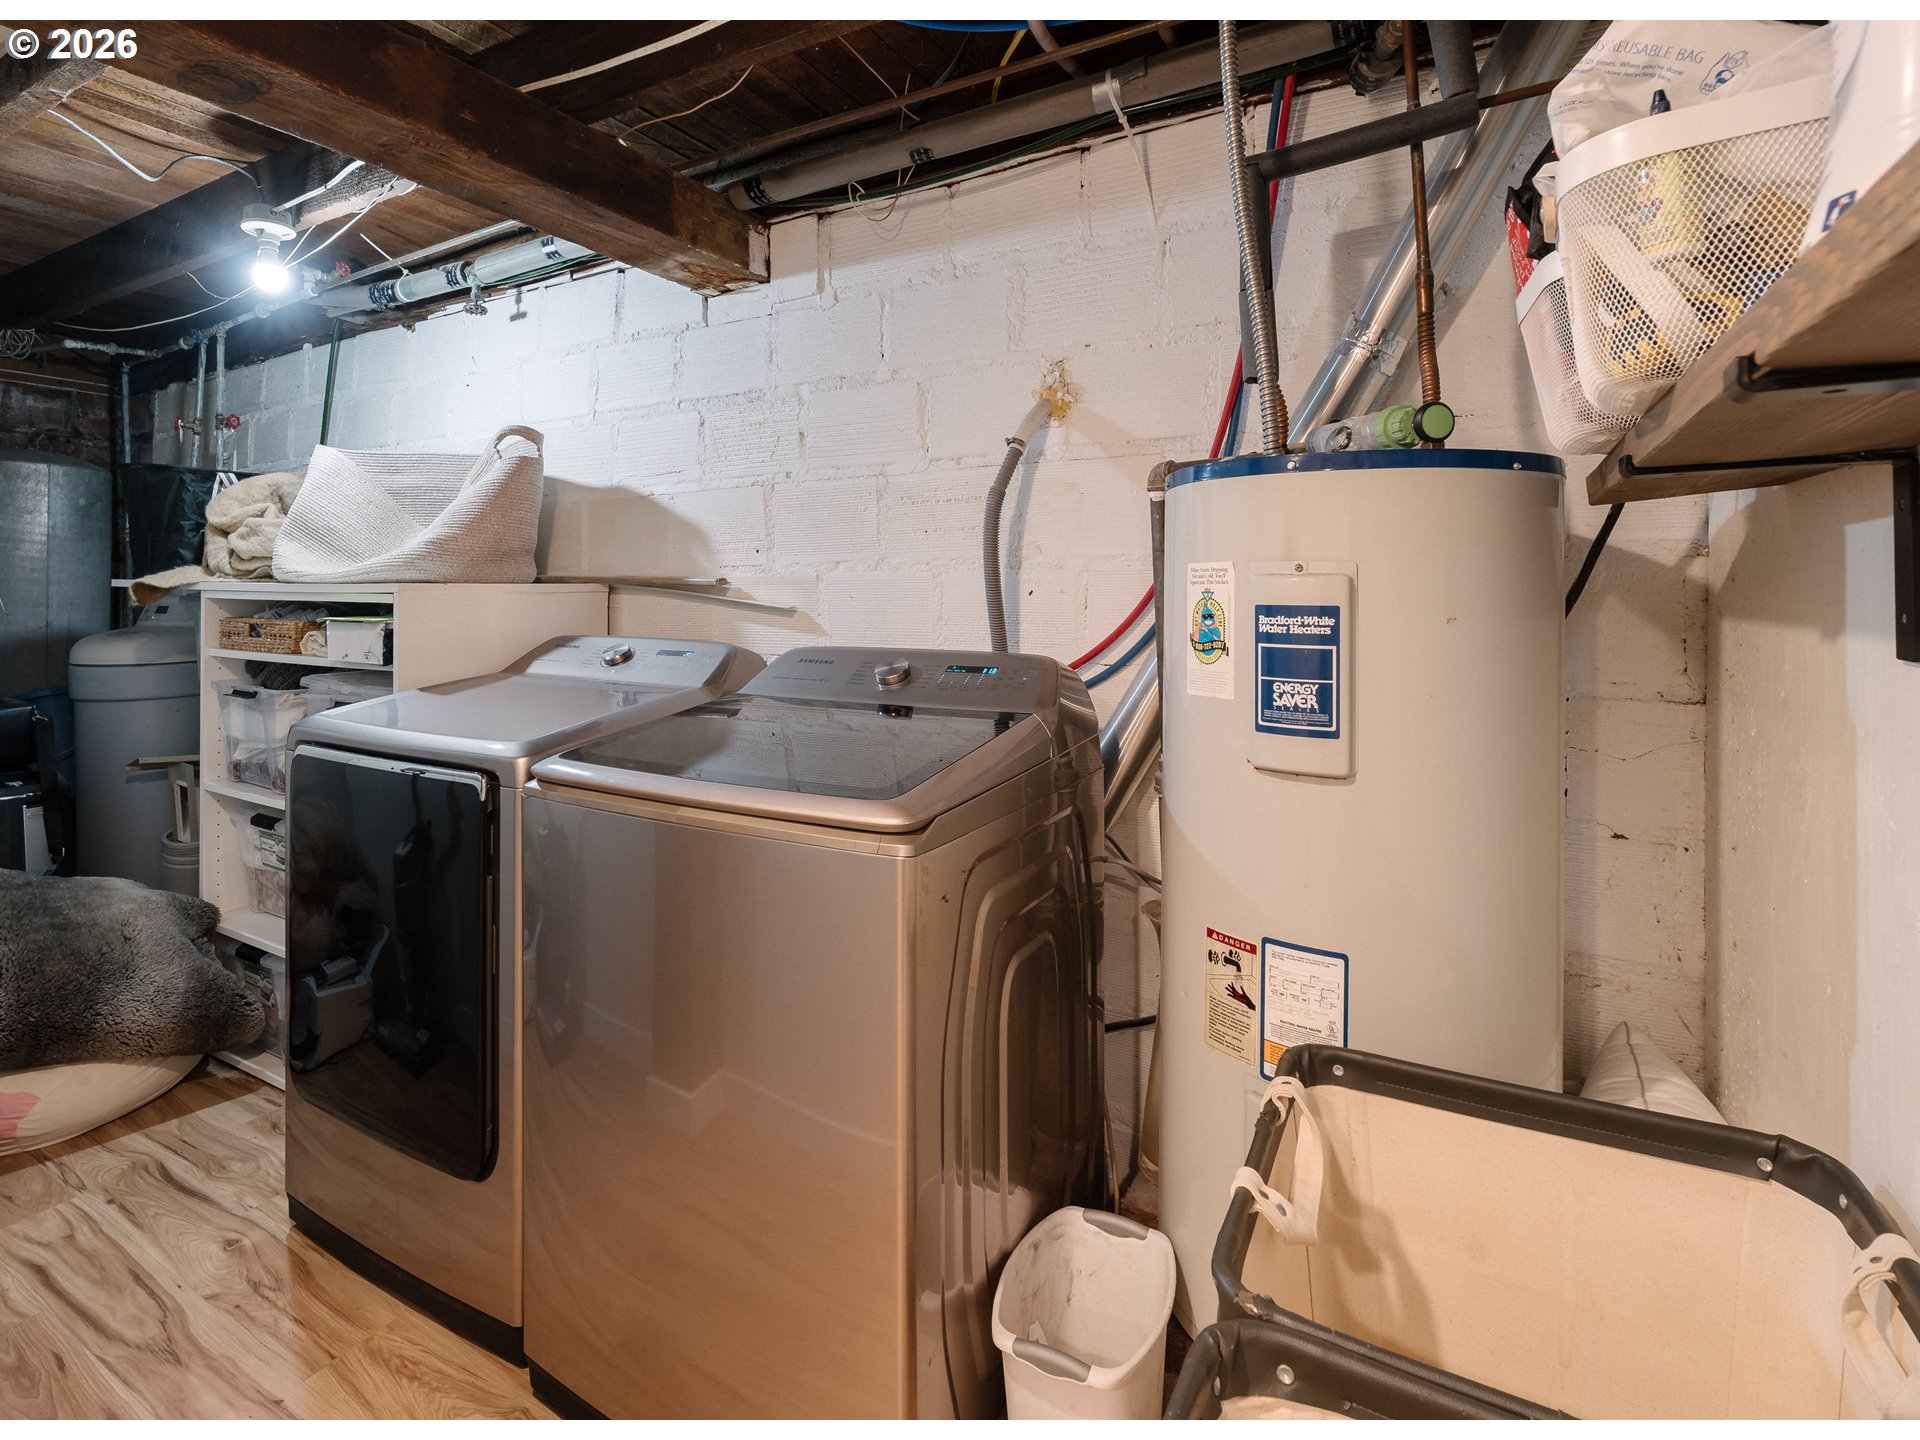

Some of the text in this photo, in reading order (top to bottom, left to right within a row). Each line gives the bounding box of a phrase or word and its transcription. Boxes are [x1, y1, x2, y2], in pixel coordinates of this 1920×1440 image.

[1675, 48, 1706, 64] BAG
[1258, 624, 1332, 635] Water Heaters
[1272, 682, 1319, 695] ENERGY
[1272, 693, 1319, 709] SAVER
[1218, 934, 1251, 951] DANGER
